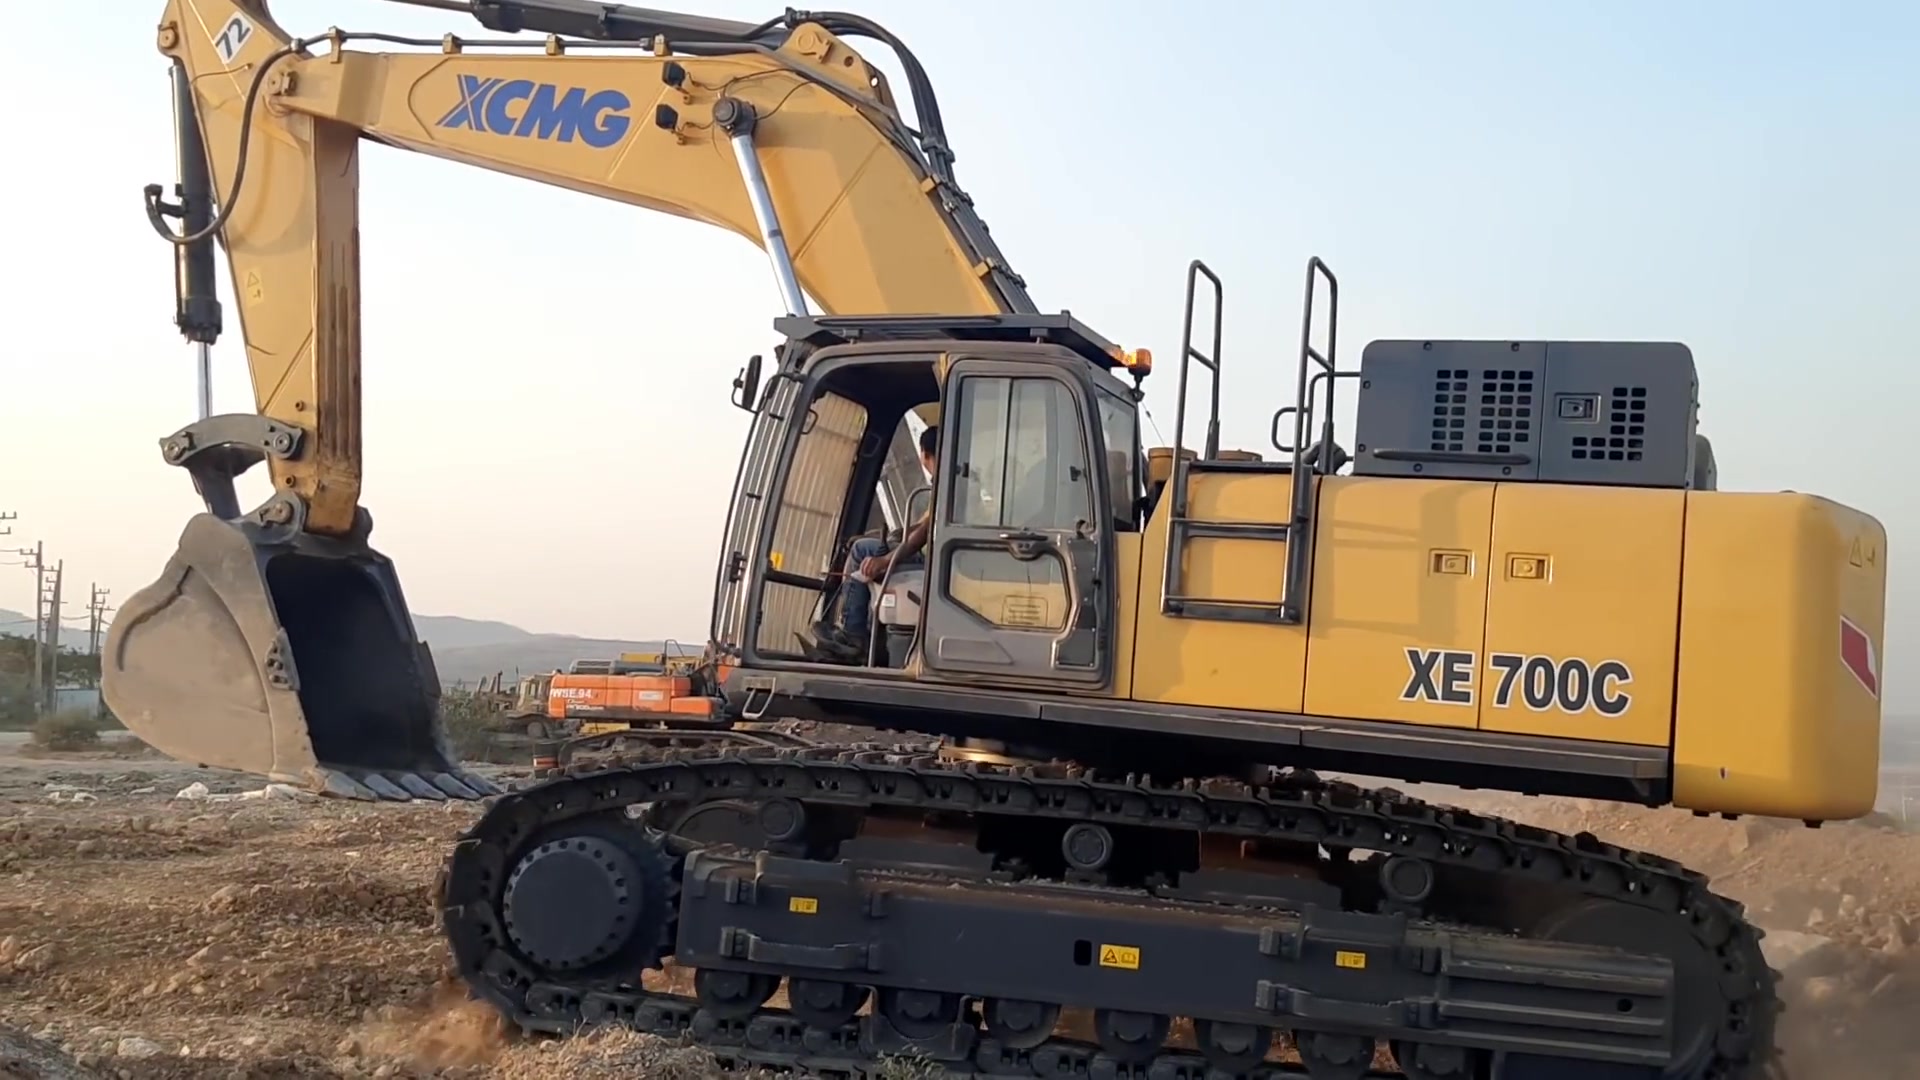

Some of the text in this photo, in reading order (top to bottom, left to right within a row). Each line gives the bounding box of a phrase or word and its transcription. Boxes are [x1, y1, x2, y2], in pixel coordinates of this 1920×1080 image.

[215, 17, 251, 60] 72
[435, 73, 631, 149] XCMG
[1400, 647, 1632, 716] XE 700C
